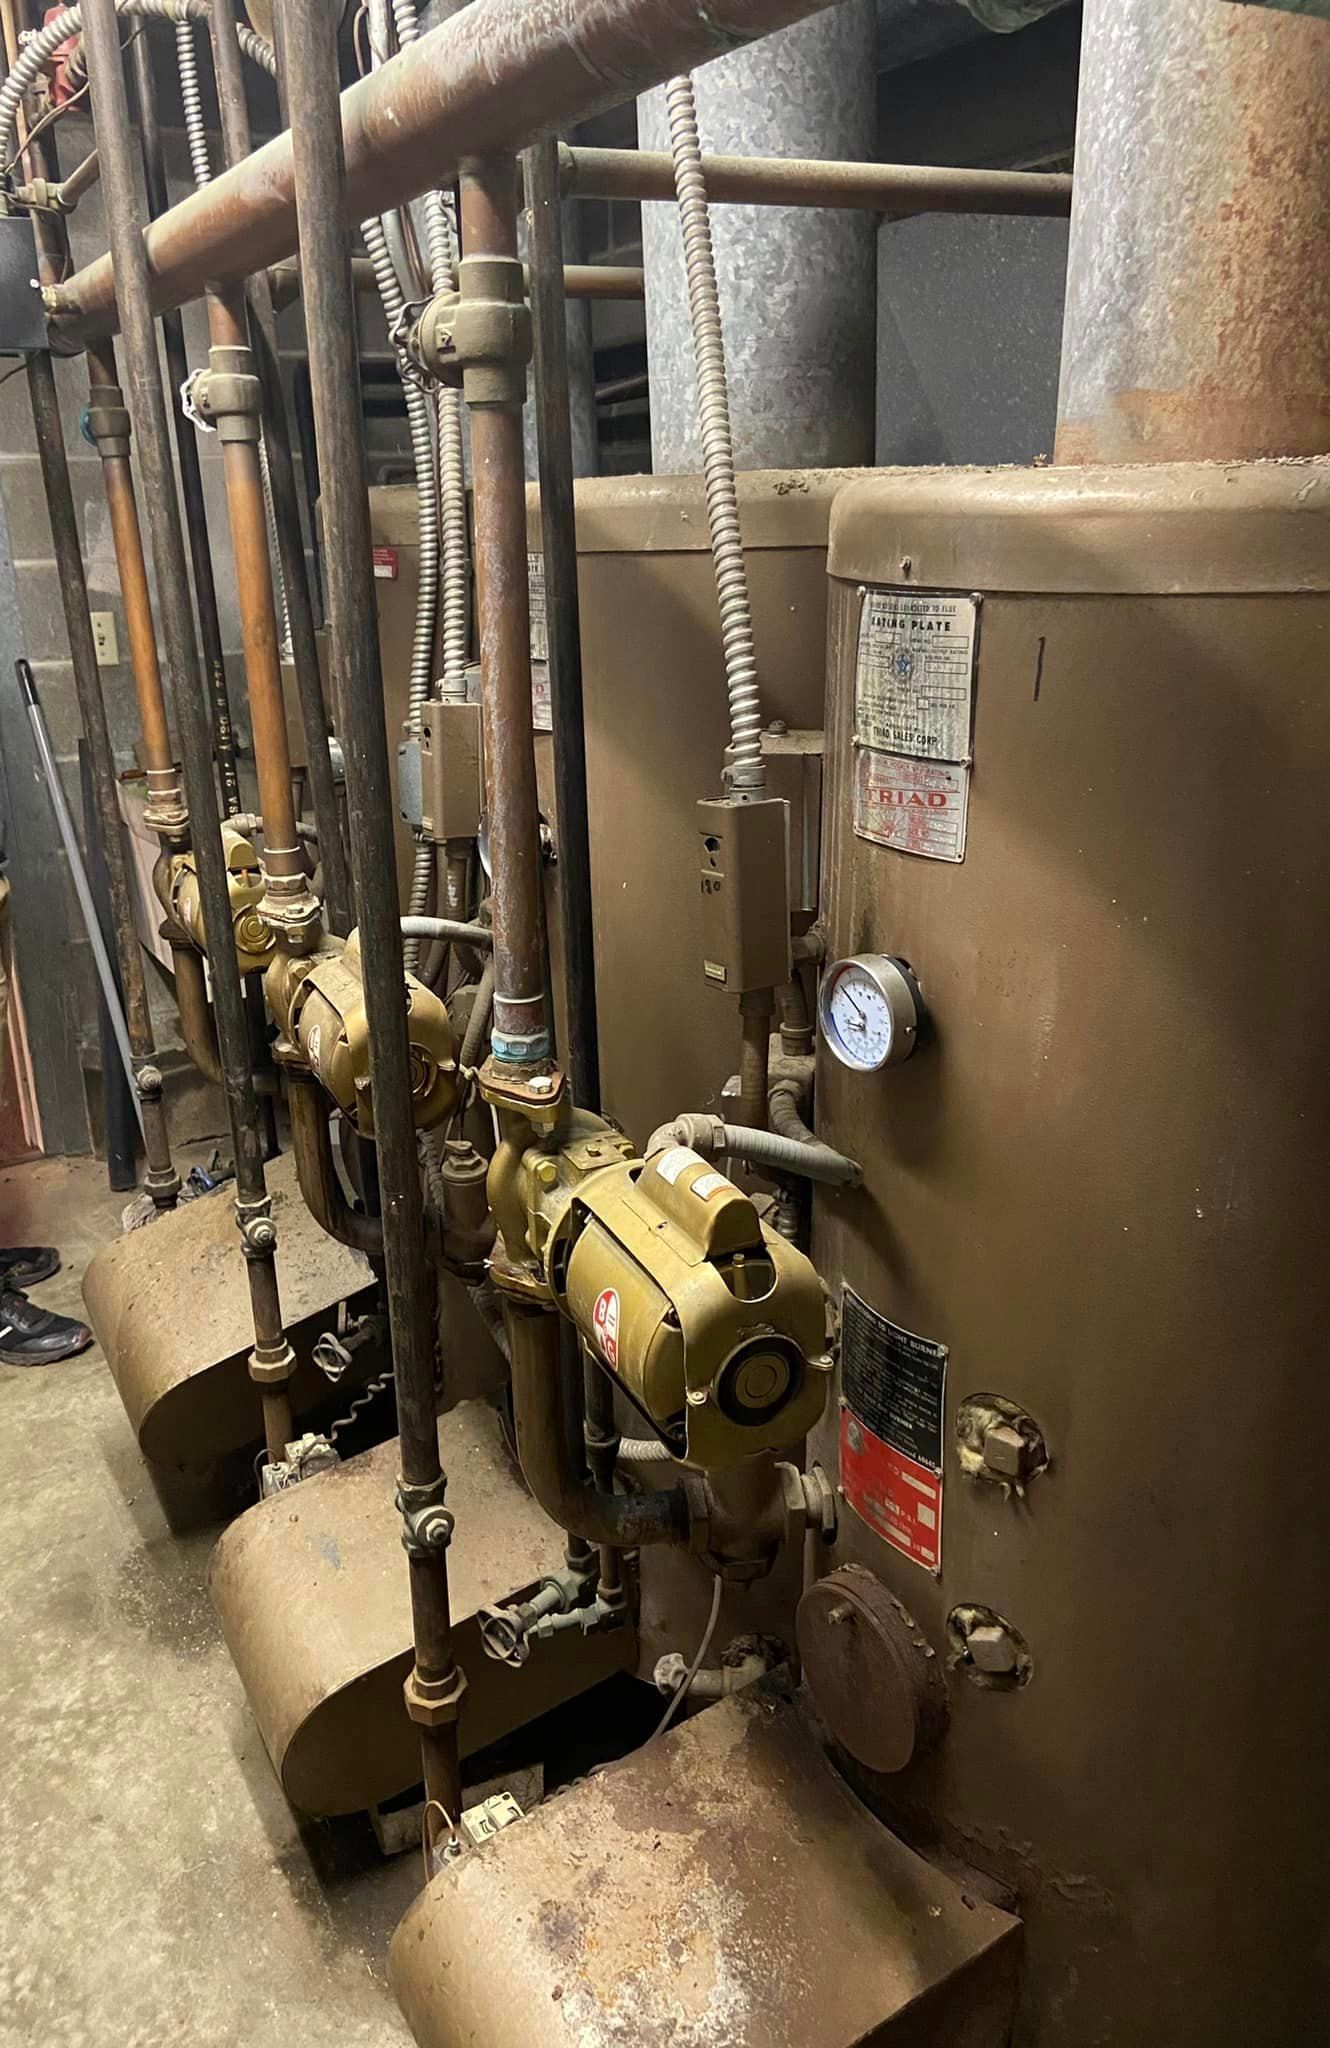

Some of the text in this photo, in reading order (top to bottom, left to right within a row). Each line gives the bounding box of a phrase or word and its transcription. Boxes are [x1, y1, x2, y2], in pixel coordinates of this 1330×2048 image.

[911, 619, 951, 632] PLATE
[892, 729, 913, 742] SALES
[864, 787, 948, 807] TRIAD
